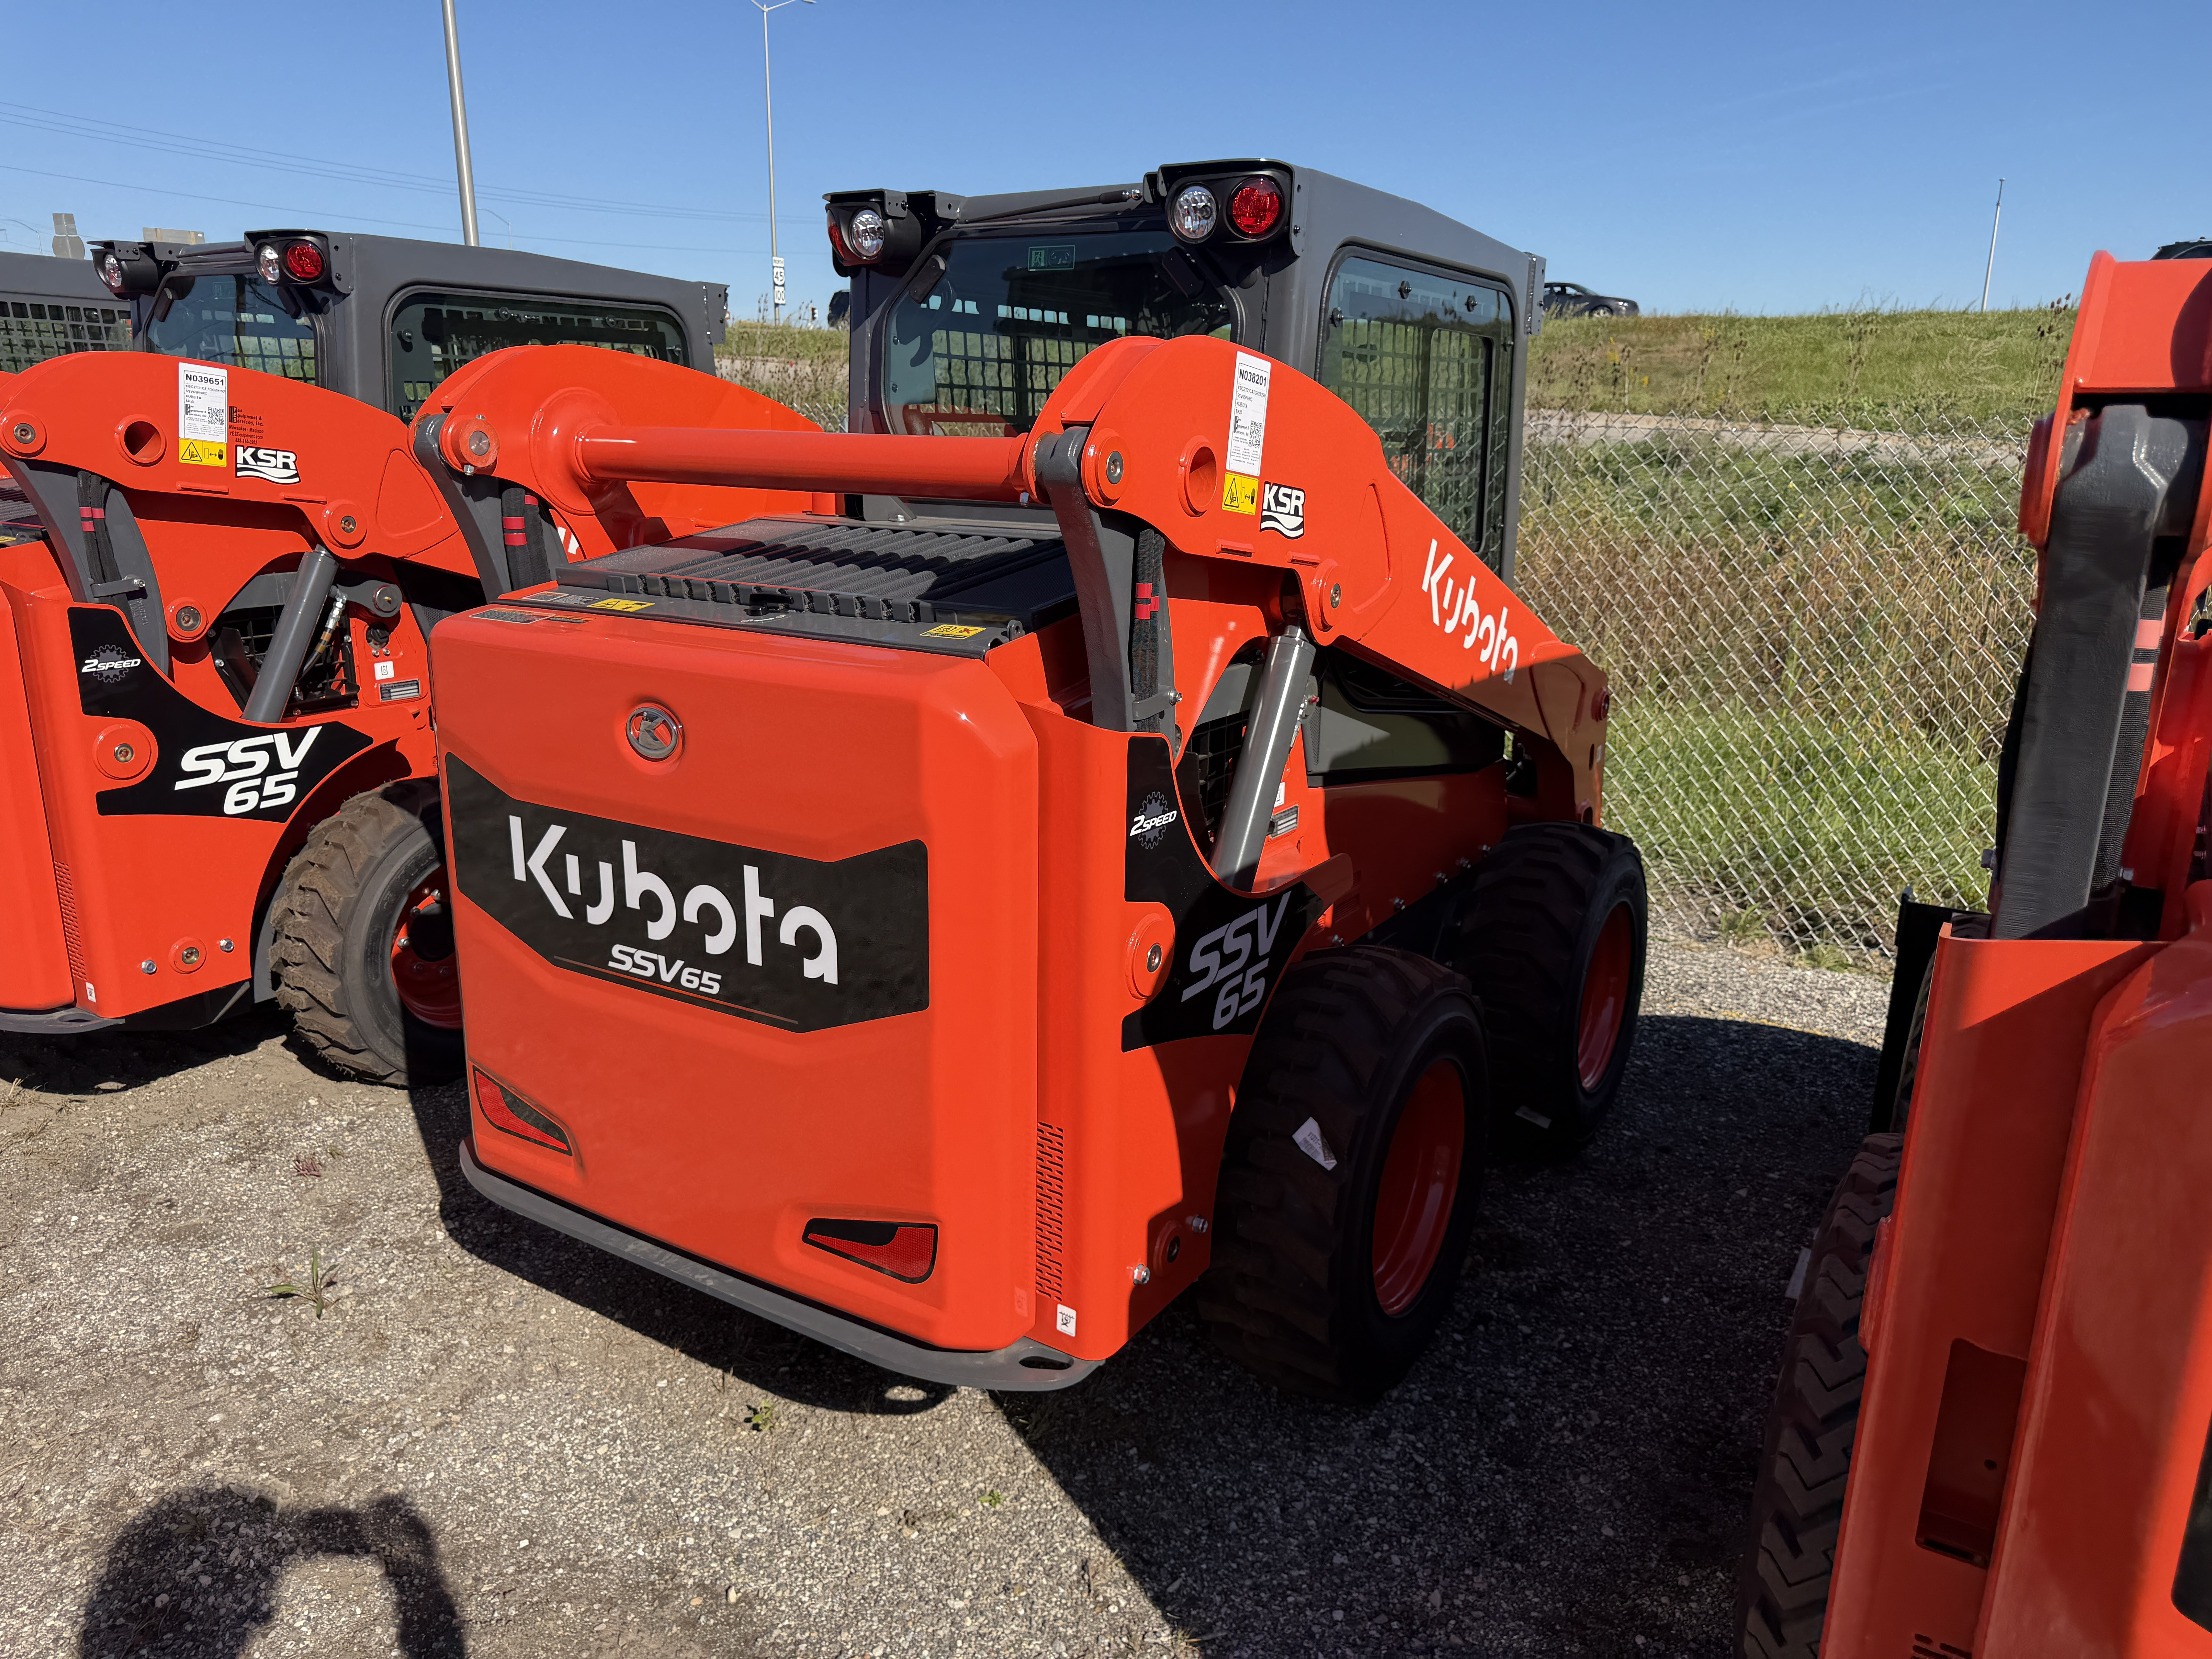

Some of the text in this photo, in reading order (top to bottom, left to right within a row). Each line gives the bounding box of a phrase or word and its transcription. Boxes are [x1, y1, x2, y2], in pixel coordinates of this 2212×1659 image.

[186, 374, 223, 386] N039651
[1239, 369, 1266, 386] N038201
[237, 446, 296, 469] KSR
[1263, 484, 1305, 516] KSR
[1422, 538, 1518, 685] Kubota
[174, 726, 322, 791] SSV
[223, 771, 299, 815] 65
[509, 815, 838, 985] Kubota
[608, 944, 722, 994] SSV65
[1181, 891, 1291, 1002] SSV
[1213, 958, 1269, 1030] 65
